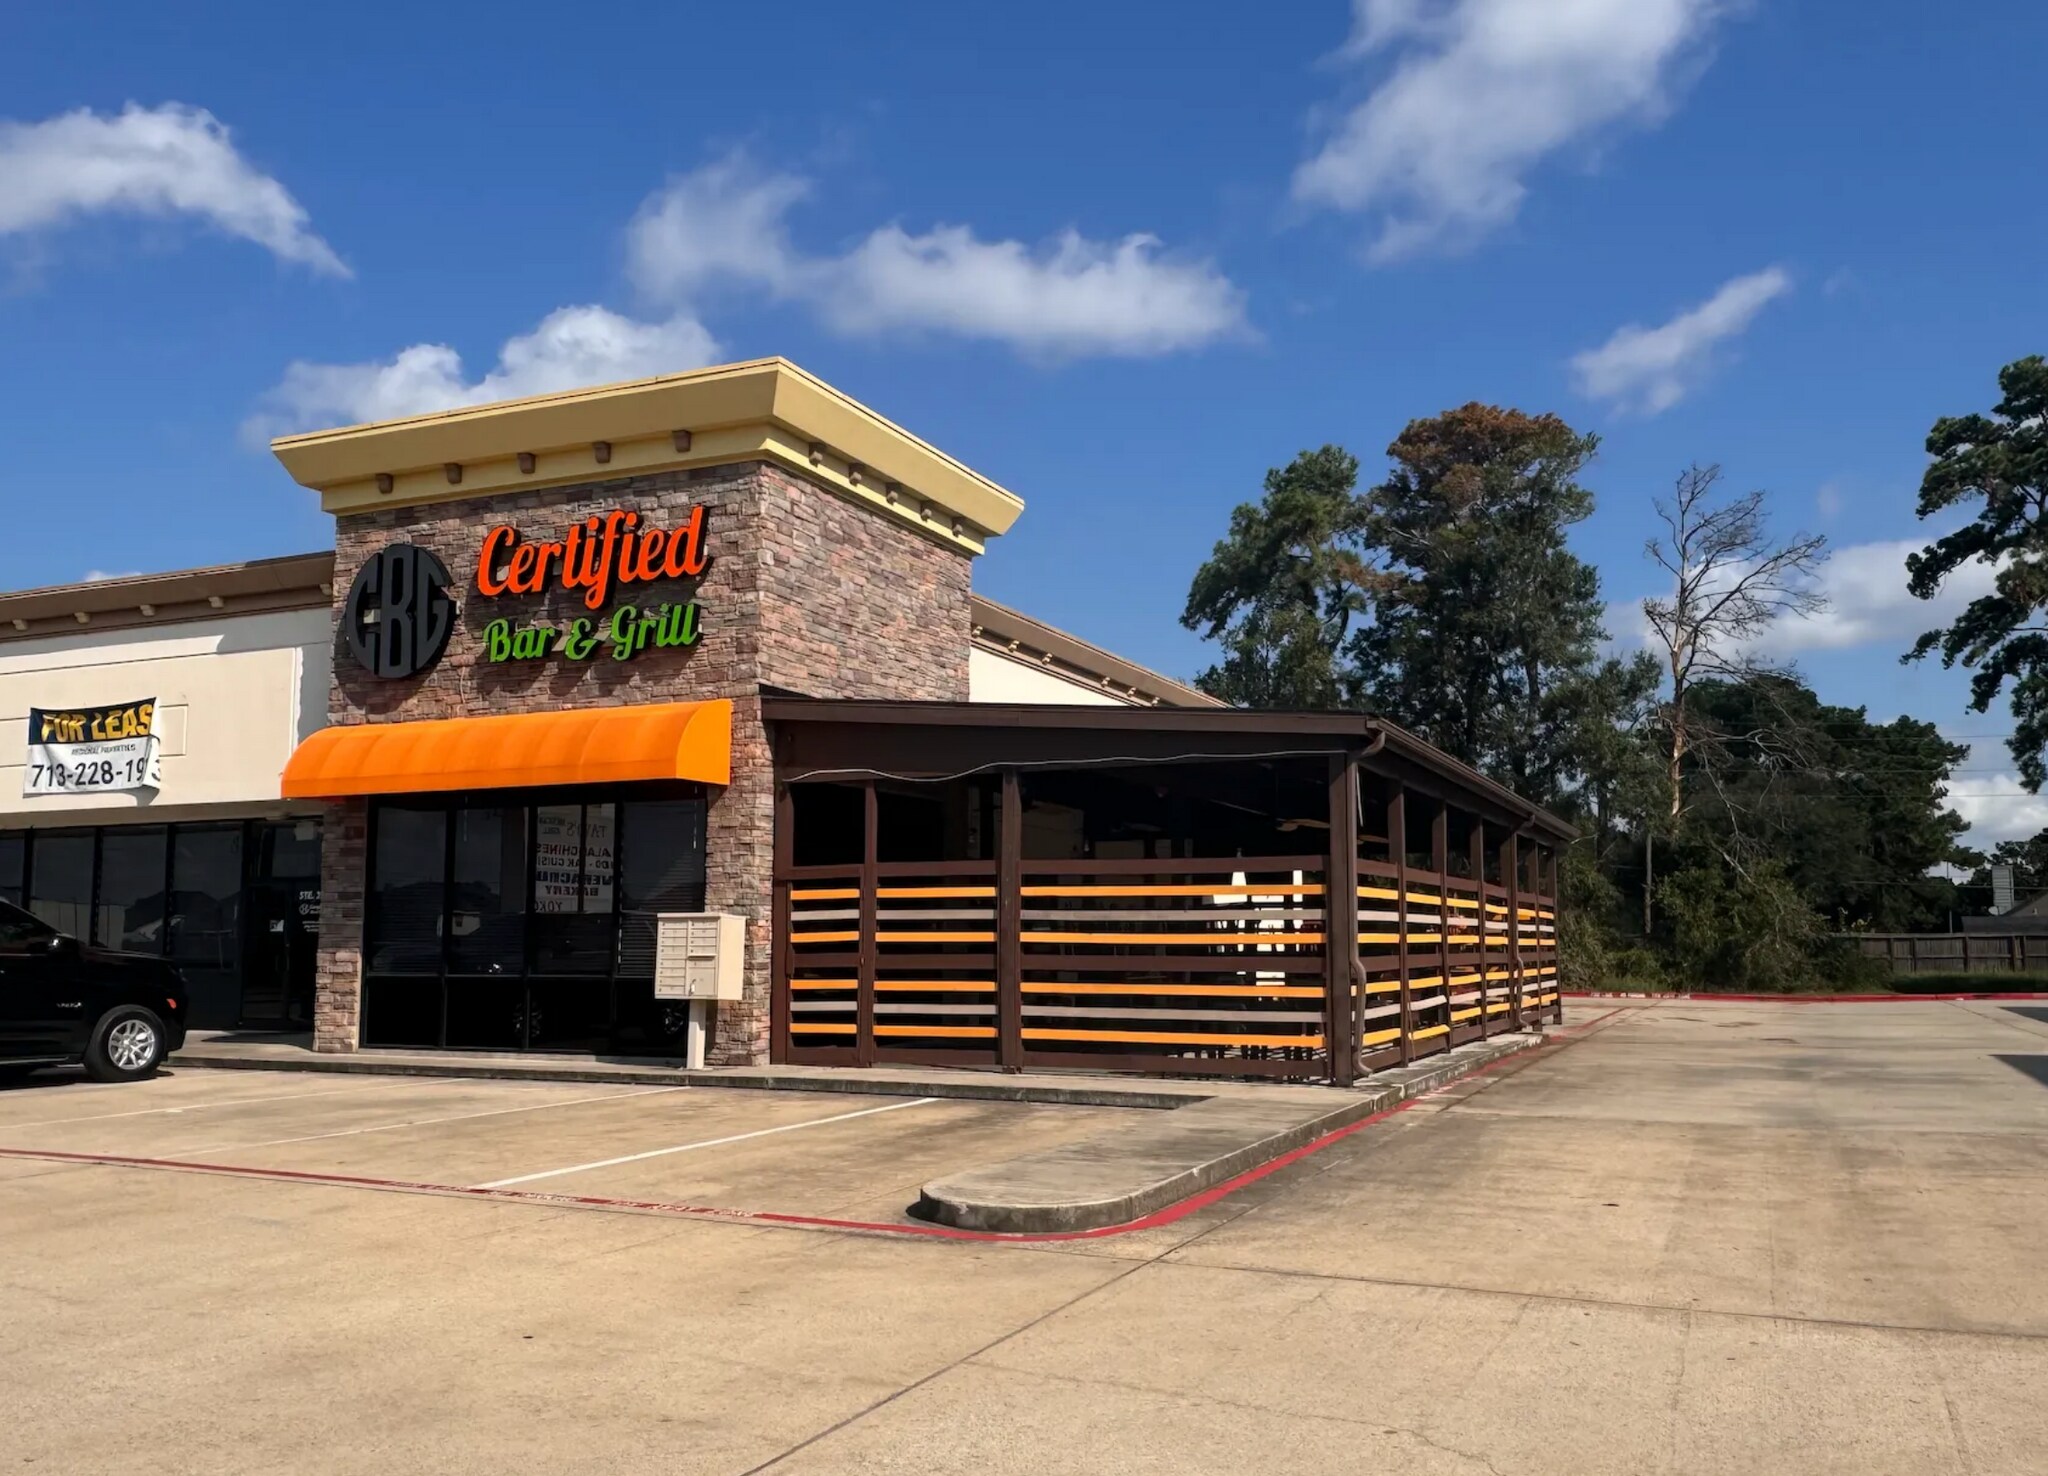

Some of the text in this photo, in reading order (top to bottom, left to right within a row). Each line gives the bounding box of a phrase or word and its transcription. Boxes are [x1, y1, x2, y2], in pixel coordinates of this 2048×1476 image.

[477, 505, 706, 610] Certified
[346, 543, 453, 678] CBG
[484, 603, 699, 662] Bar & Grill
